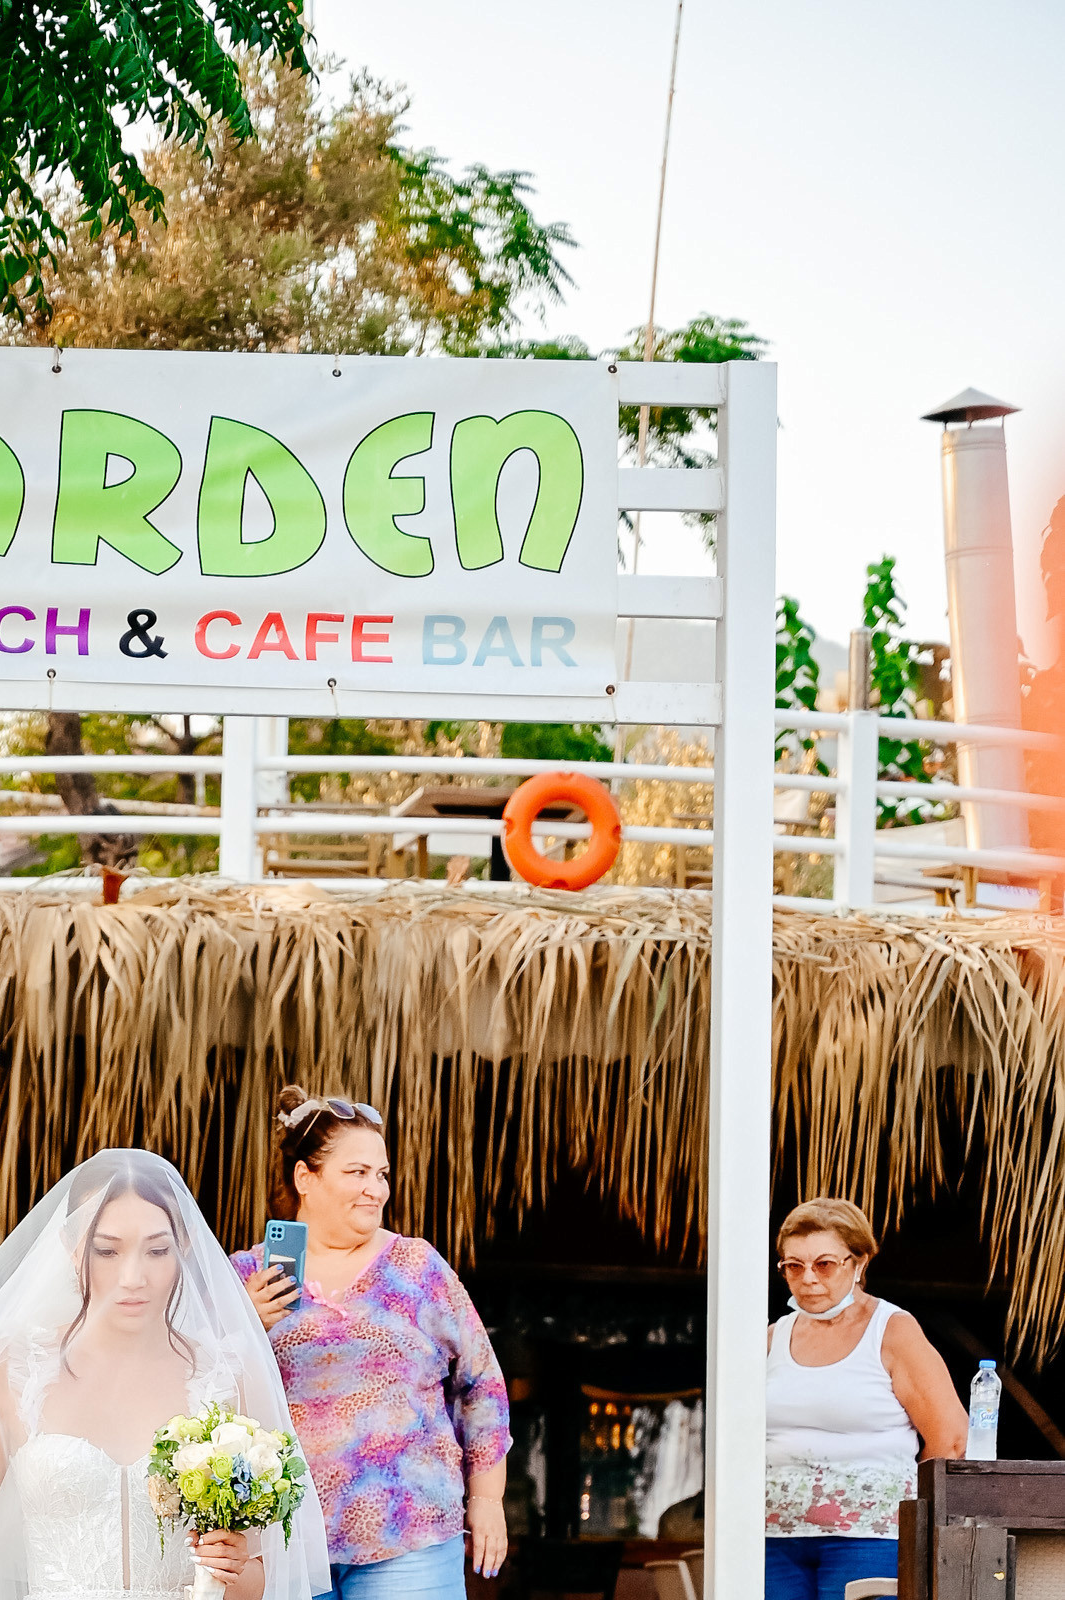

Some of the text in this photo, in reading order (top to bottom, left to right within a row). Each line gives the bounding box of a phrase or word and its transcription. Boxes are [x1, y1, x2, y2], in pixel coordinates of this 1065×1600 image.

[119, 608, 169, 659] &
[194, 611, 394, 664] CAFE
[422, 616, 579, 667] BAR
